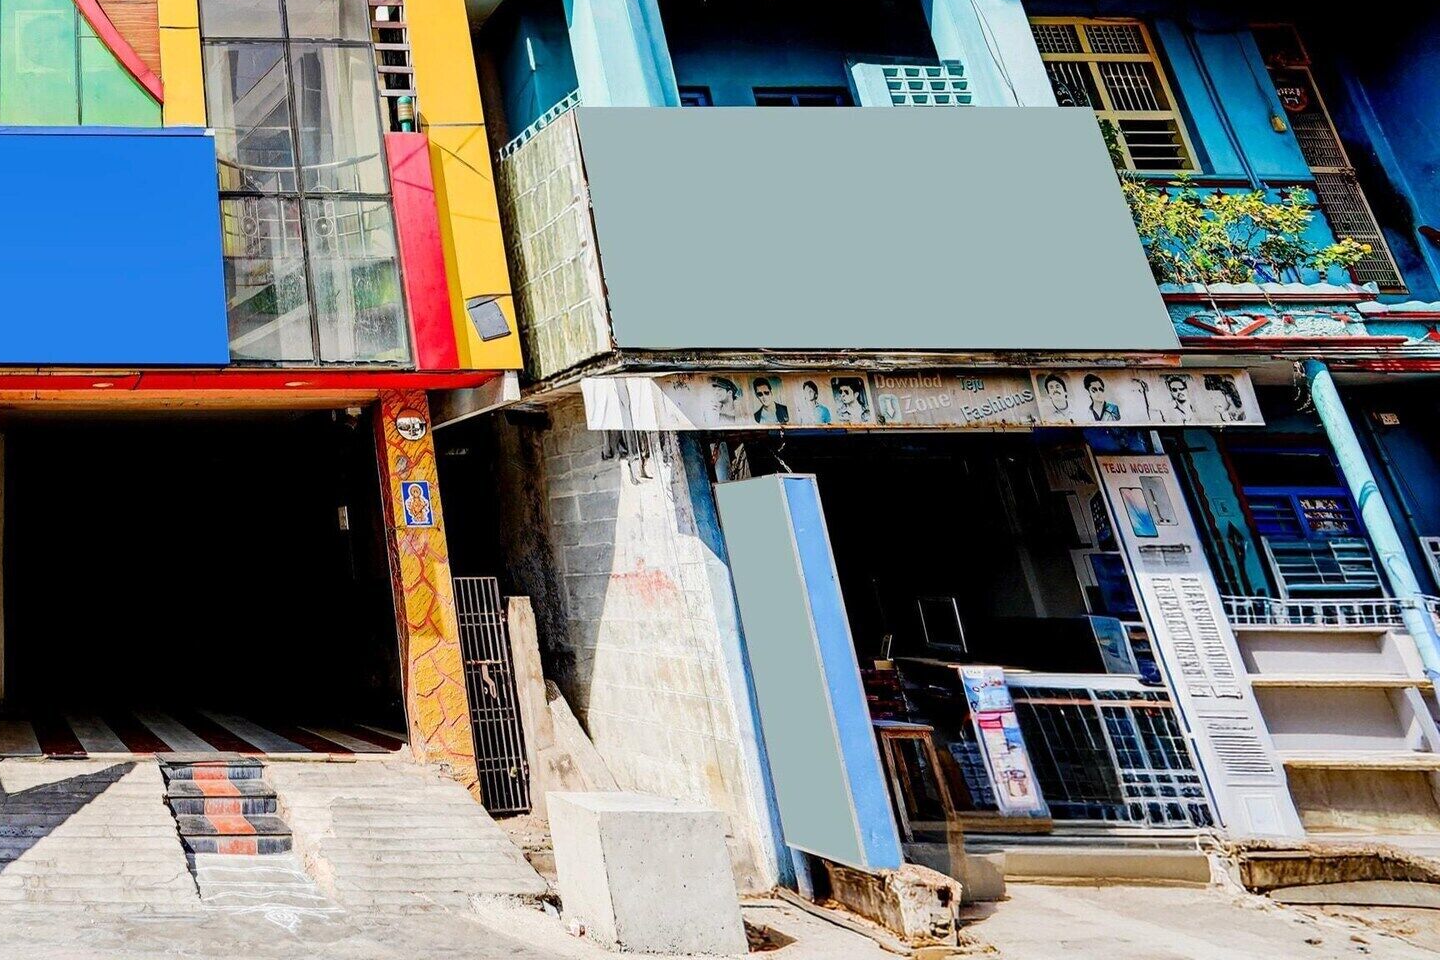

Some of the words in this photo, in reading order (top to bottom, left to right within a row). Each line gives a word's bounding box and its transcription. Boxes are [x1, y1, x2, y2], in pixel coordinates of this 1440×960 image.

[874, 372, 943, 389] Downlod
[957, 375, 985, 393] Teju
[900, 392, 952, 414] Zone
[960, 389, 1035, 422] Fashions
[1102, 463, 1127, 474] TEJU
[1129, 463, 1170, 474] MOBILES
